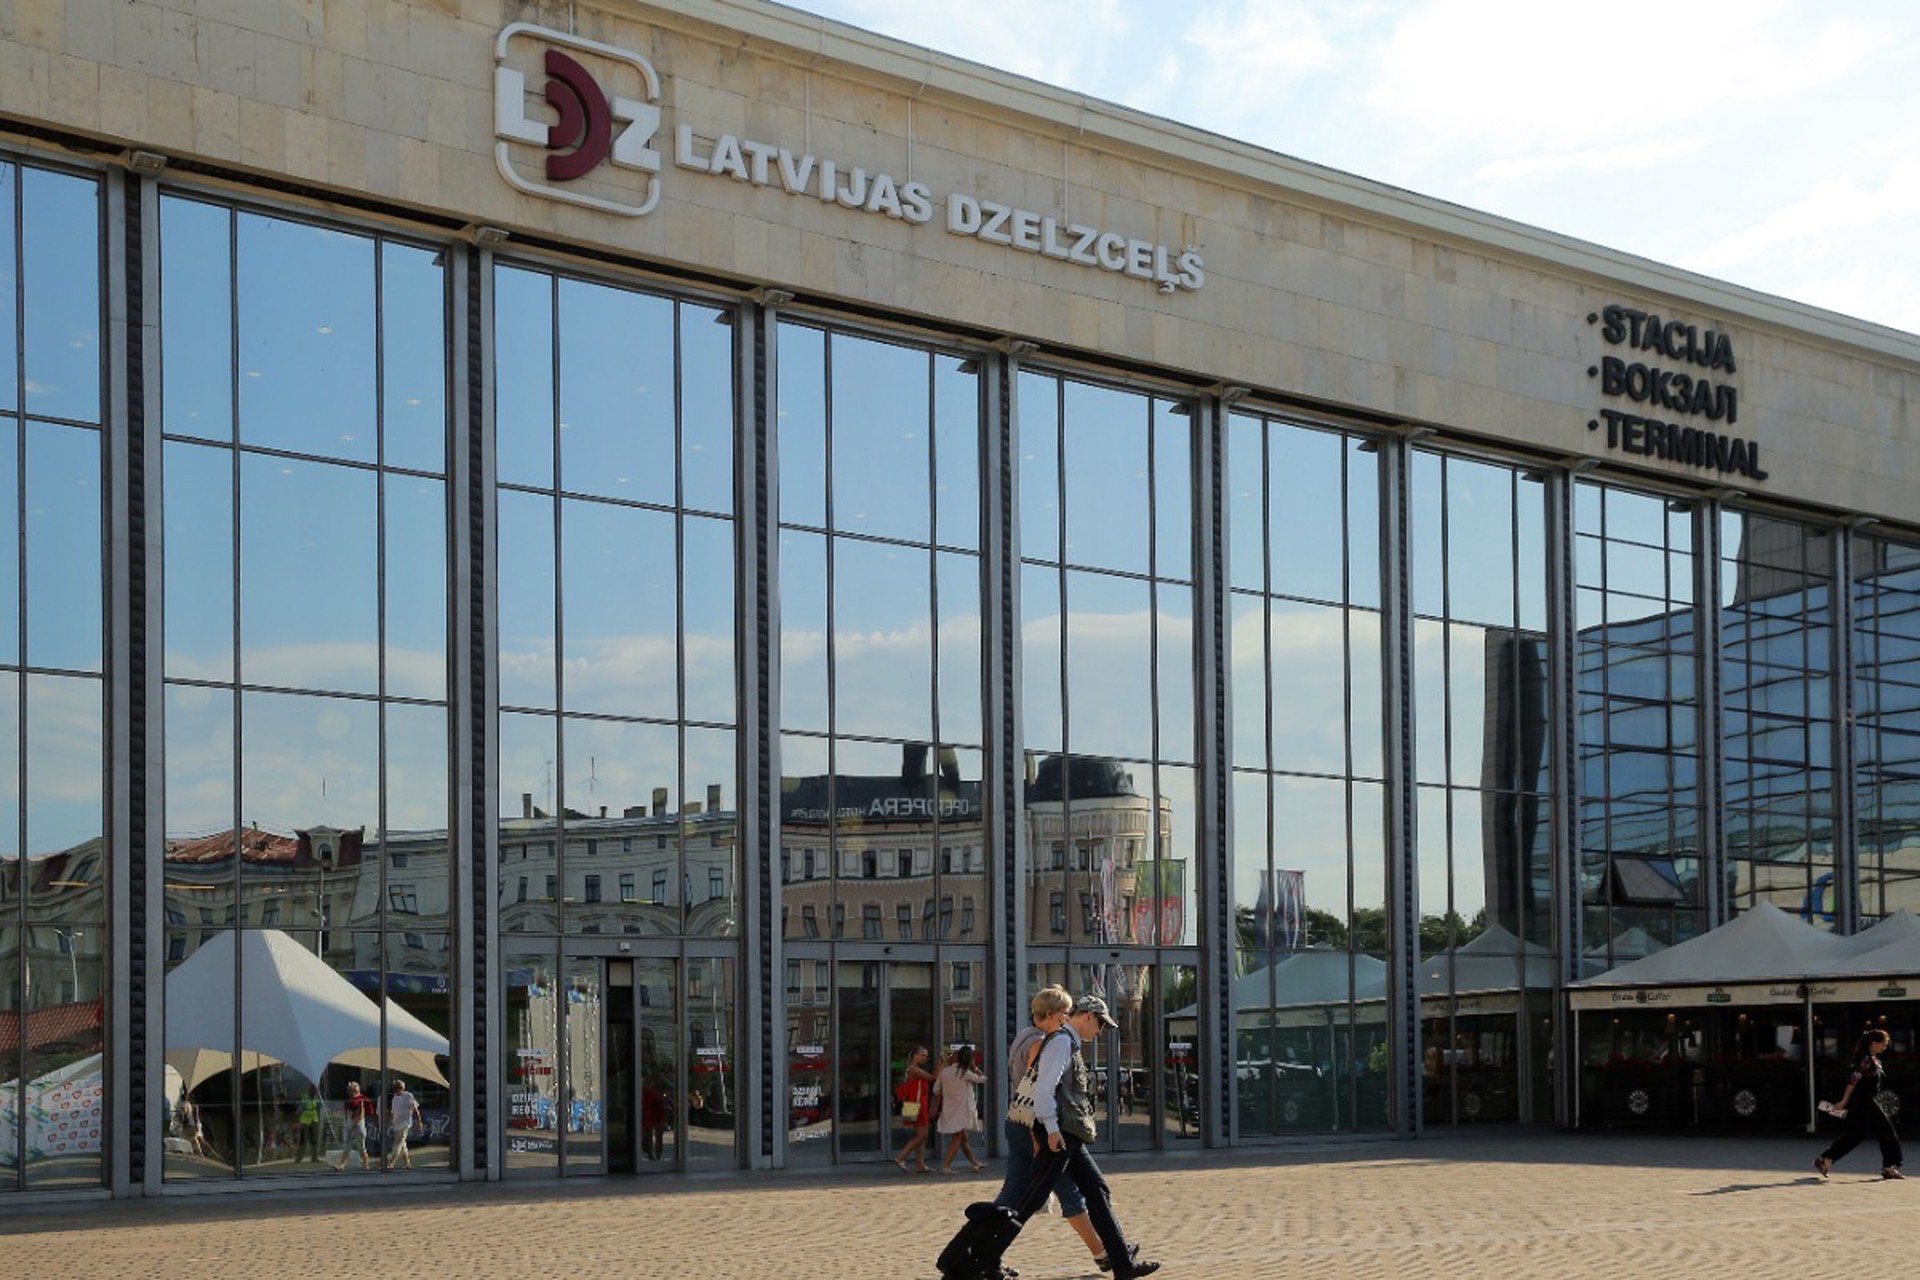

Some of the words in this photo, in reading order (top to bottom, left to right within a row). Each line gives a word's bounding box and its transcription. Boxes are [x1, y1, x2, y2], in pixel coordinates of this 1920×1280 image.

[674, 123, 933, 225] LATVIJAS
[946, 192, 1206, 294] DZELZCEĻŠ
[1602, 304, 1737, 374] STACIJA
[1602, 355, 1738, 424] ВОКЗАЛ
[1600, 408, 1769, 481] TERMINAL
